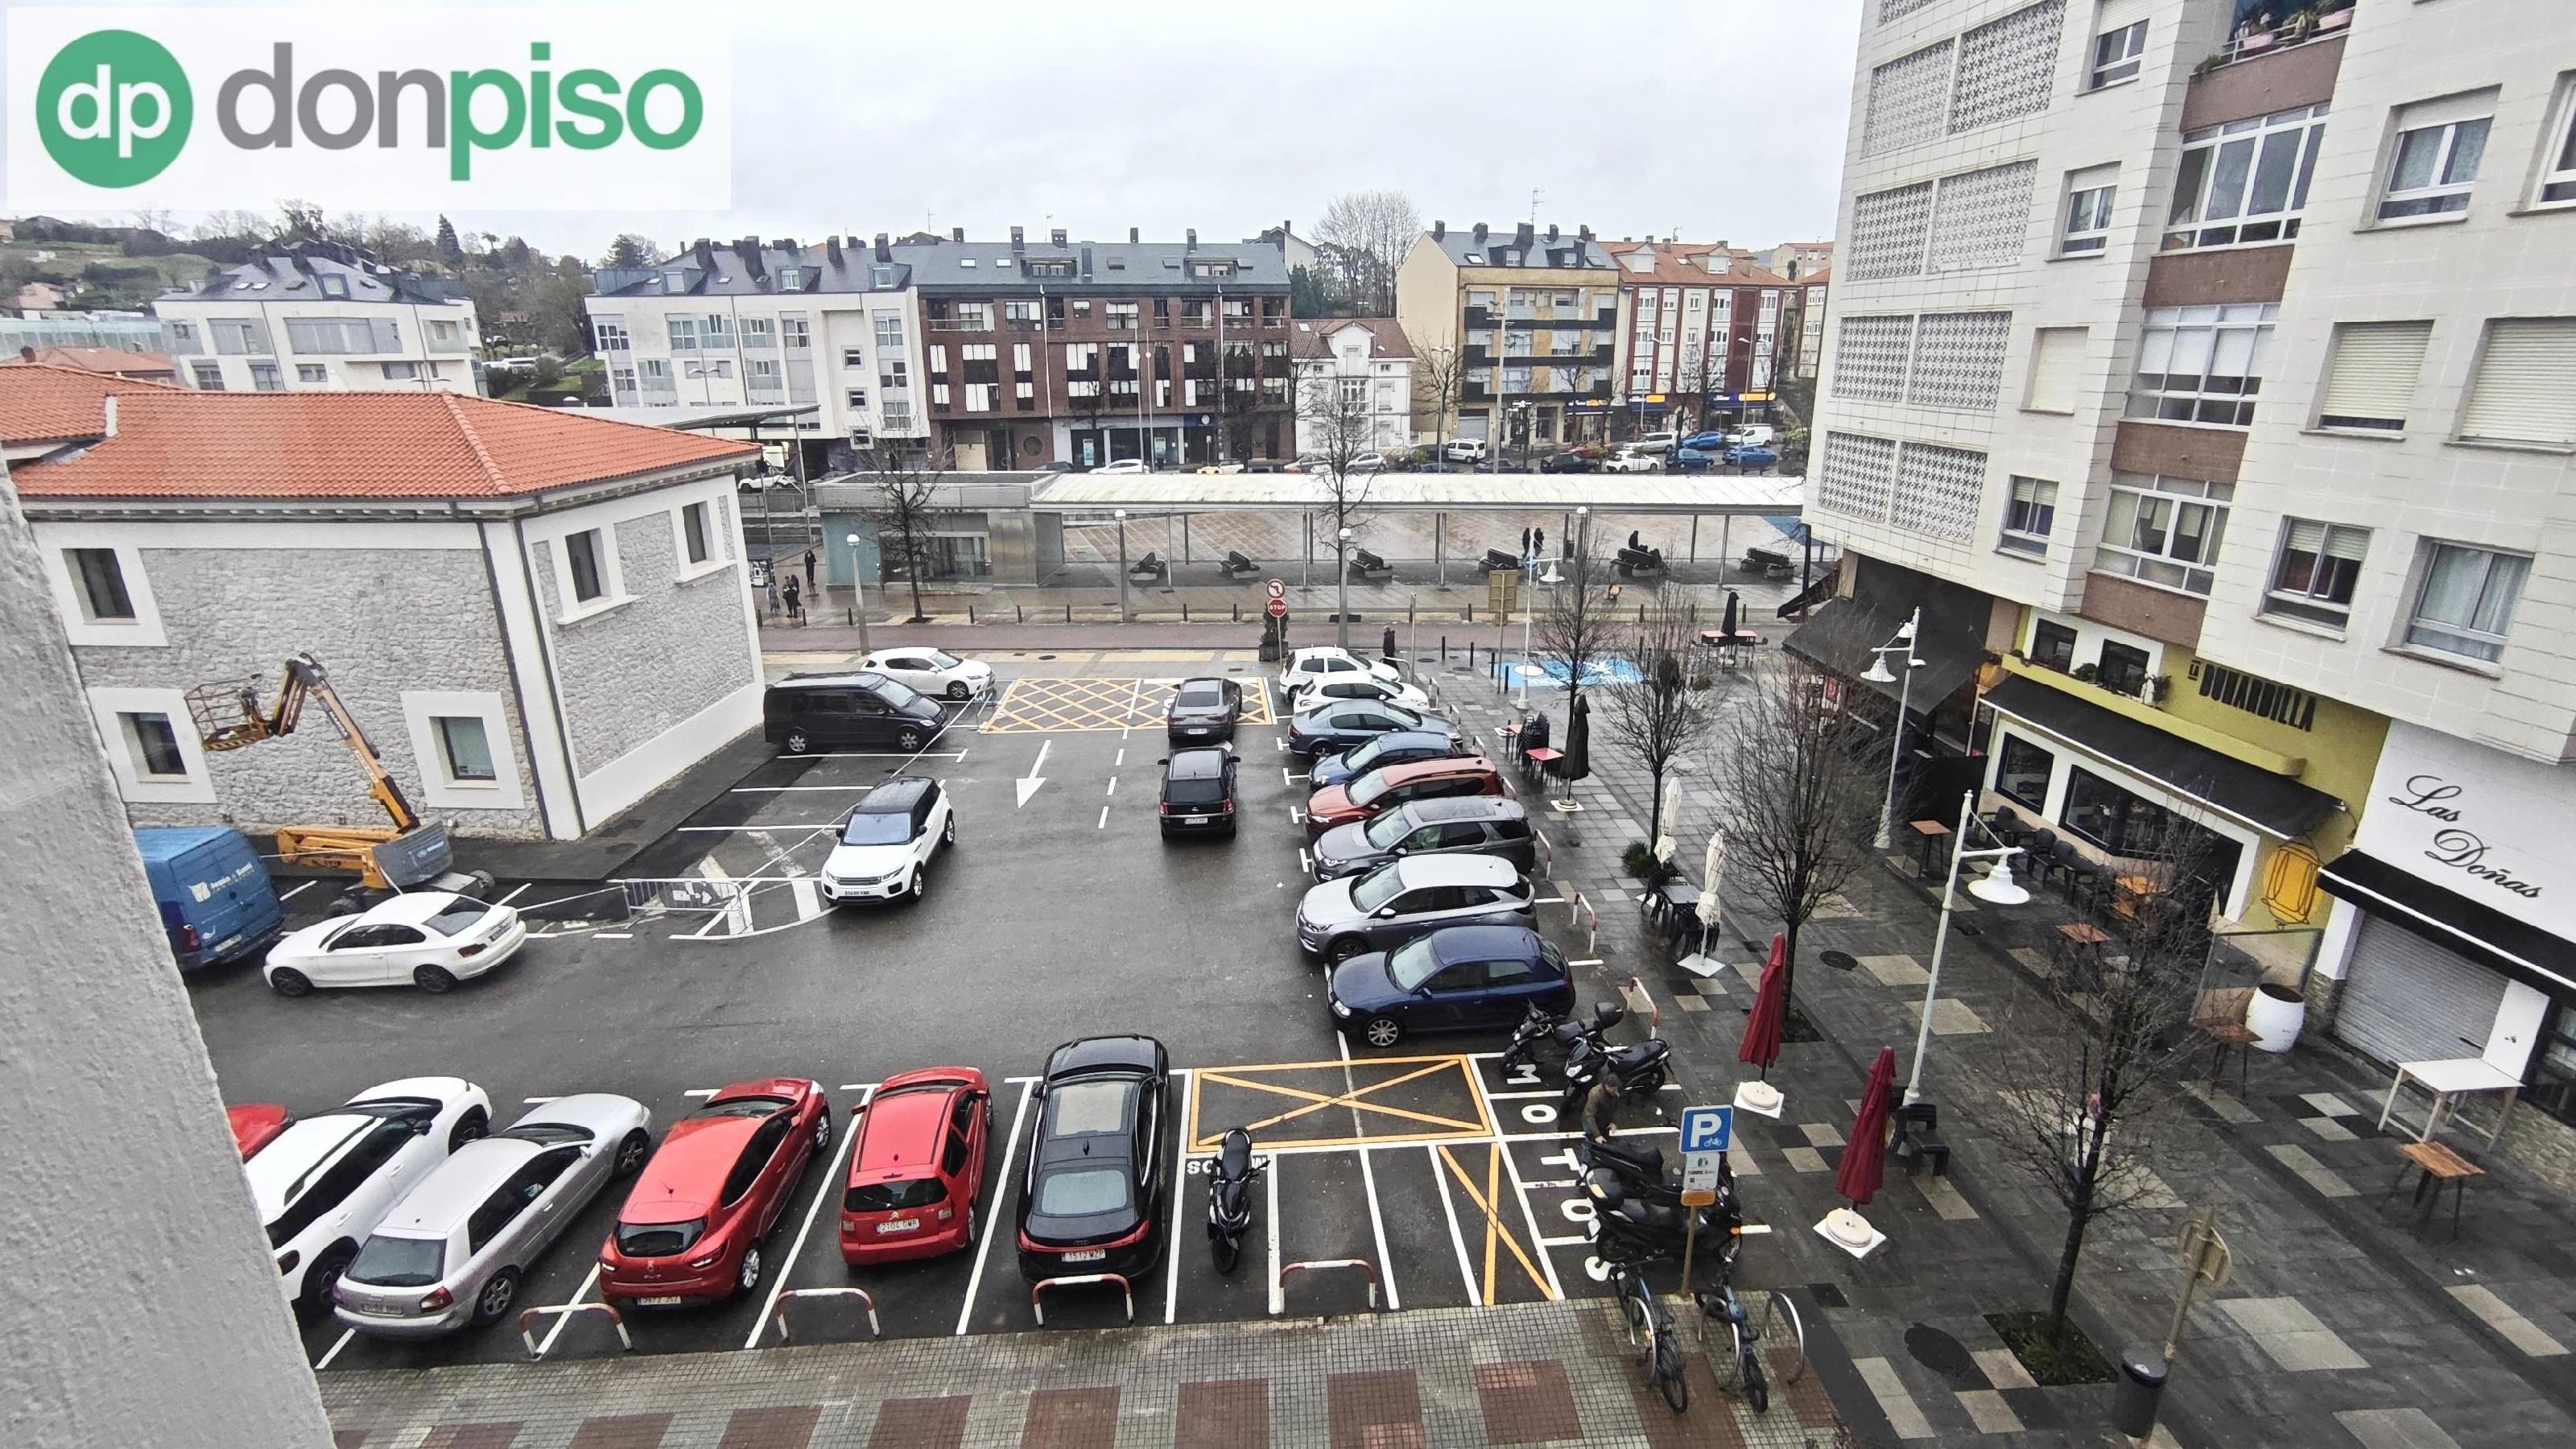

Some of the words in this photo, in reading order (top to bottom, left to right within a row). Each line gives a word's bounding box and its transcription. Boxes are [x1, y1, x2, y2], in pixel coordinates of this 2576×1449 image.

[2388, 774, 2462, 823] Las
[2425, 828, 2543, 901] Doñas
[1690, 1113, 1722, 1148] P
